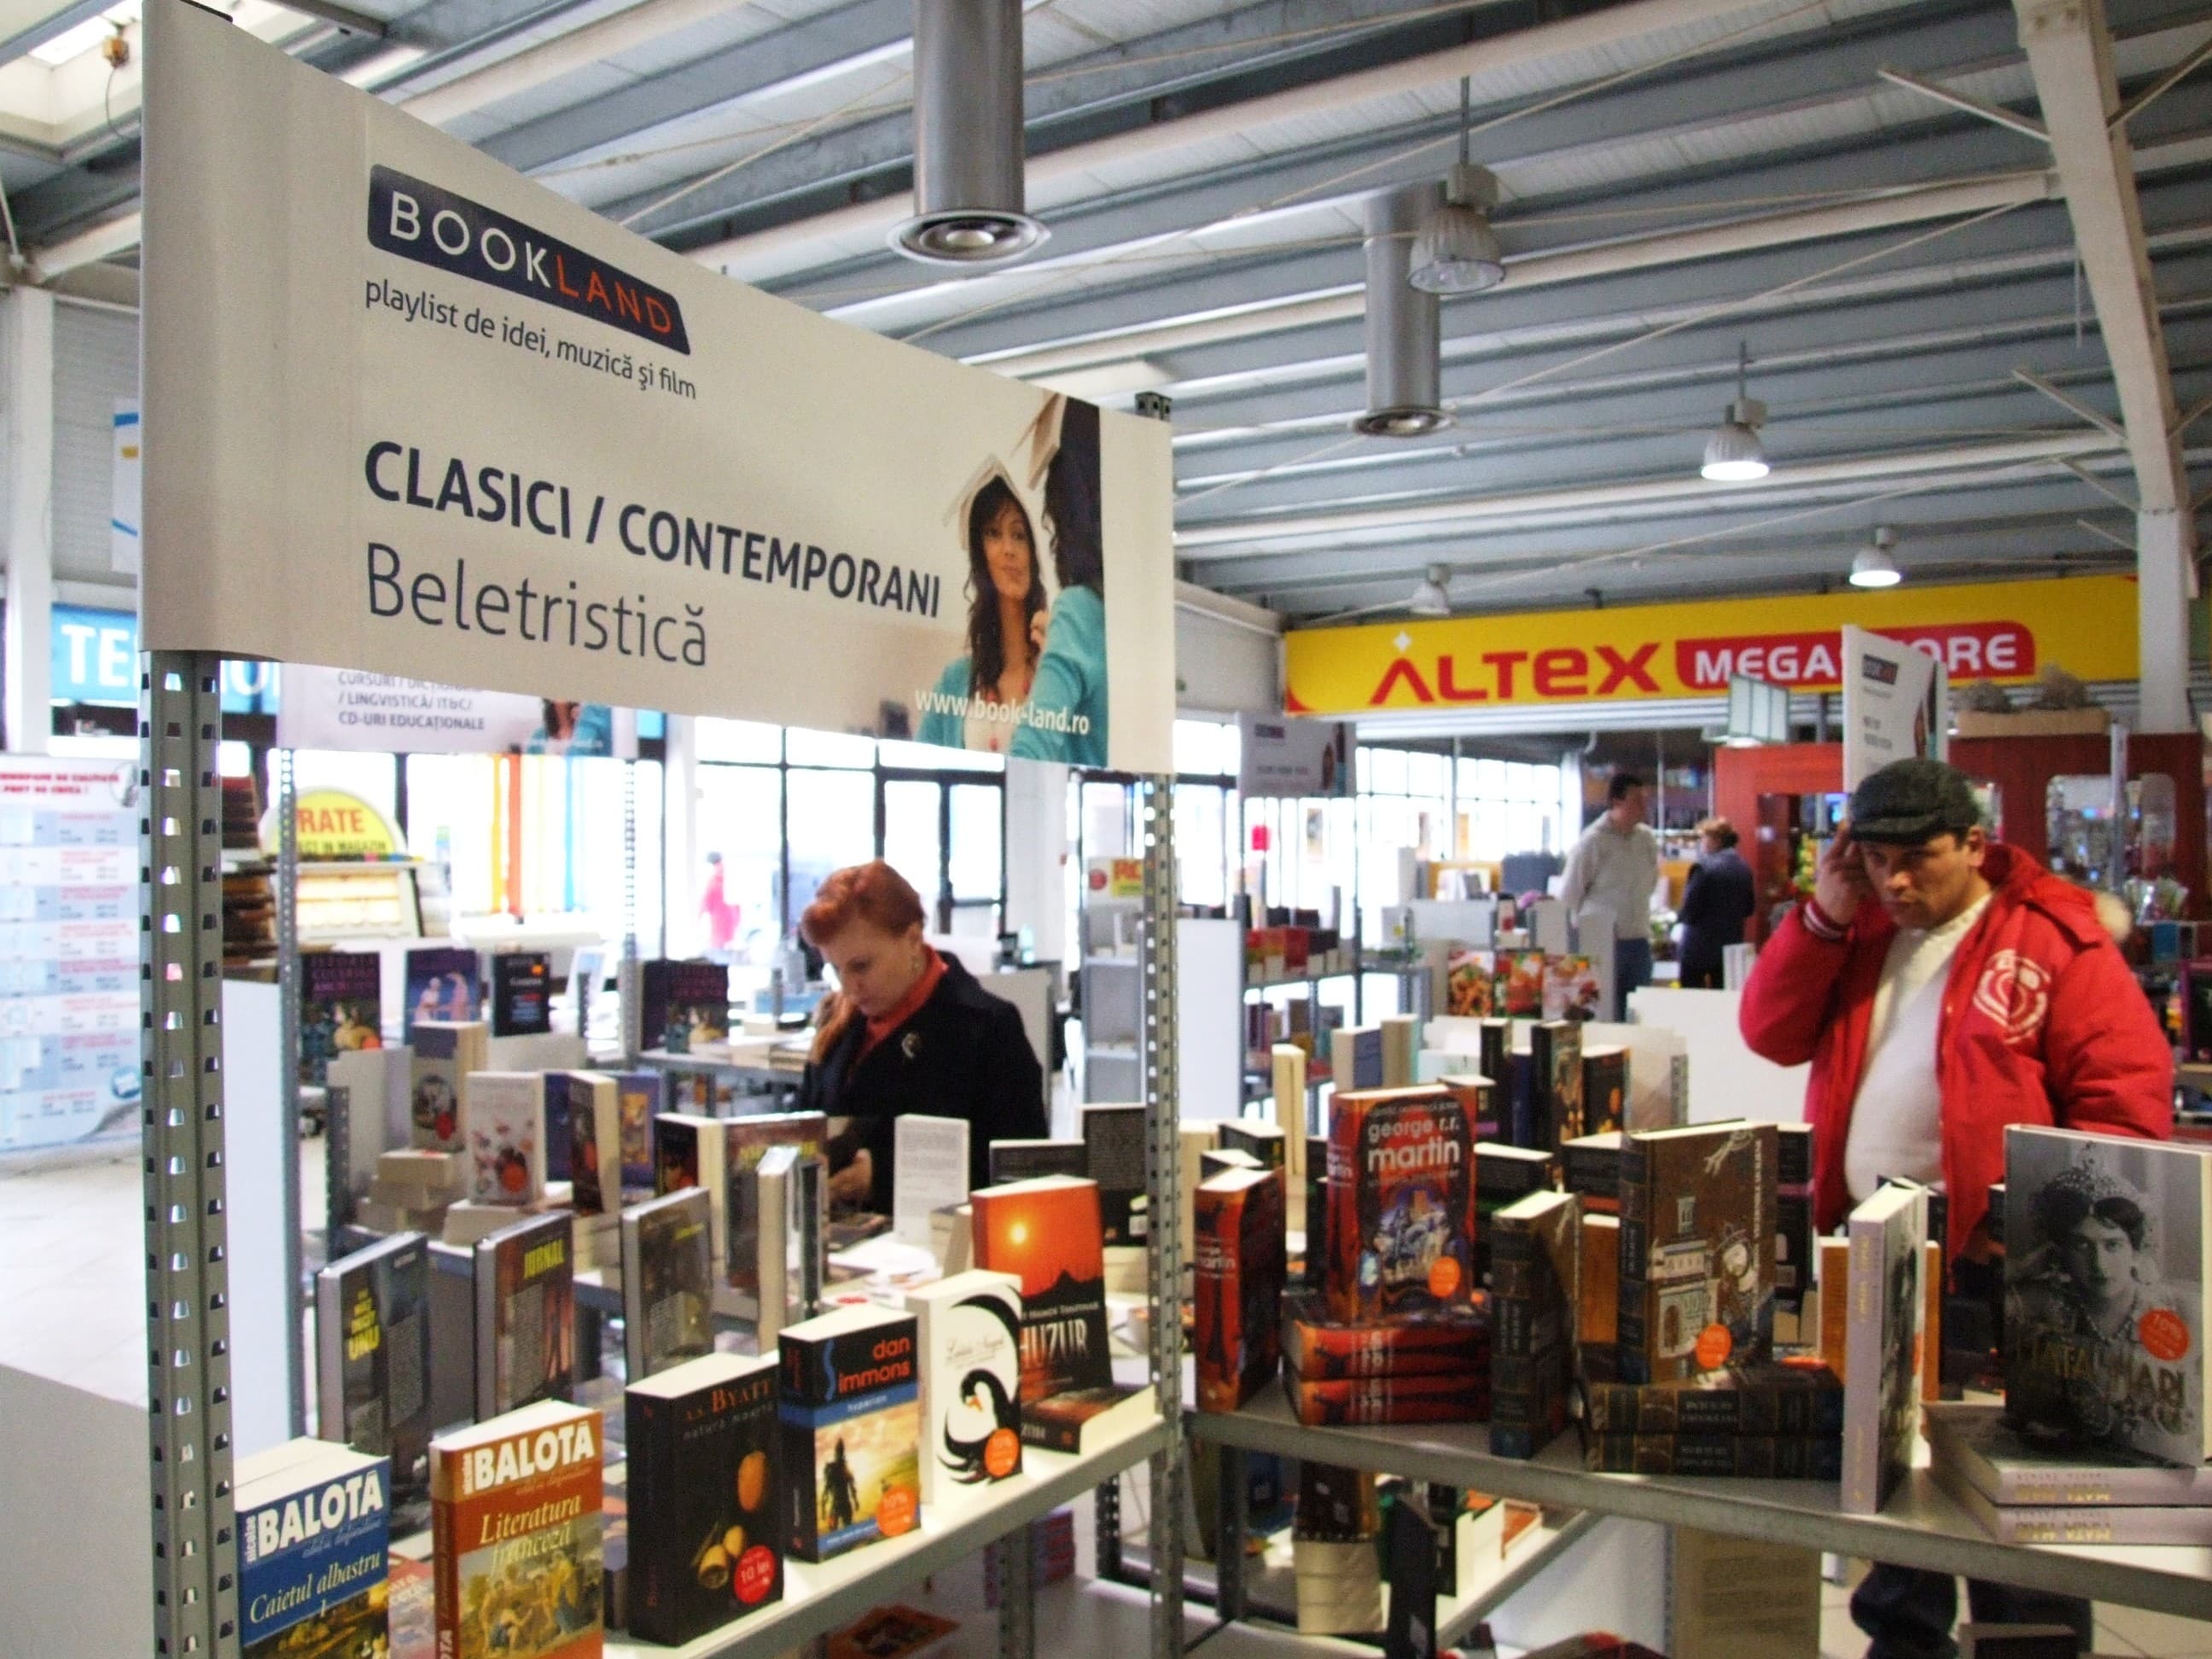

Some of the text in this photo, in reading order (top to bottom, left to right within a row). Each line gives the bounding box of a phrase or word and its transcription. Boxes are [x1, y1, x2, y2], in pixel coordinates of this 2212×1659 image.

[390, 190, 672, 334] BOOKLAND
[365, 279, 458, 328] playlist
[463, 307, 496, 338] de
[502, 316, 550, 358] idei,
[556, 338, 633, 380] muzică
[659, 366, 696, 399] film
[364, 440, 940, 619] CLASICI / CONTEMPORANI
[367, 541, 707, 667] Beletristică
[1694, 633, 2017, 682] MEGARE
[914, 689, 1090, 736] www.book-land.ro
[297, 808, 364, 833] RATE
[1367, 1119, 1435, 1144] george
[1367, 1135, 1461, 1173] martin
[873, 1336, 911, 1361] dan
[249, 1551, 381, 1624] Caietul albastru
